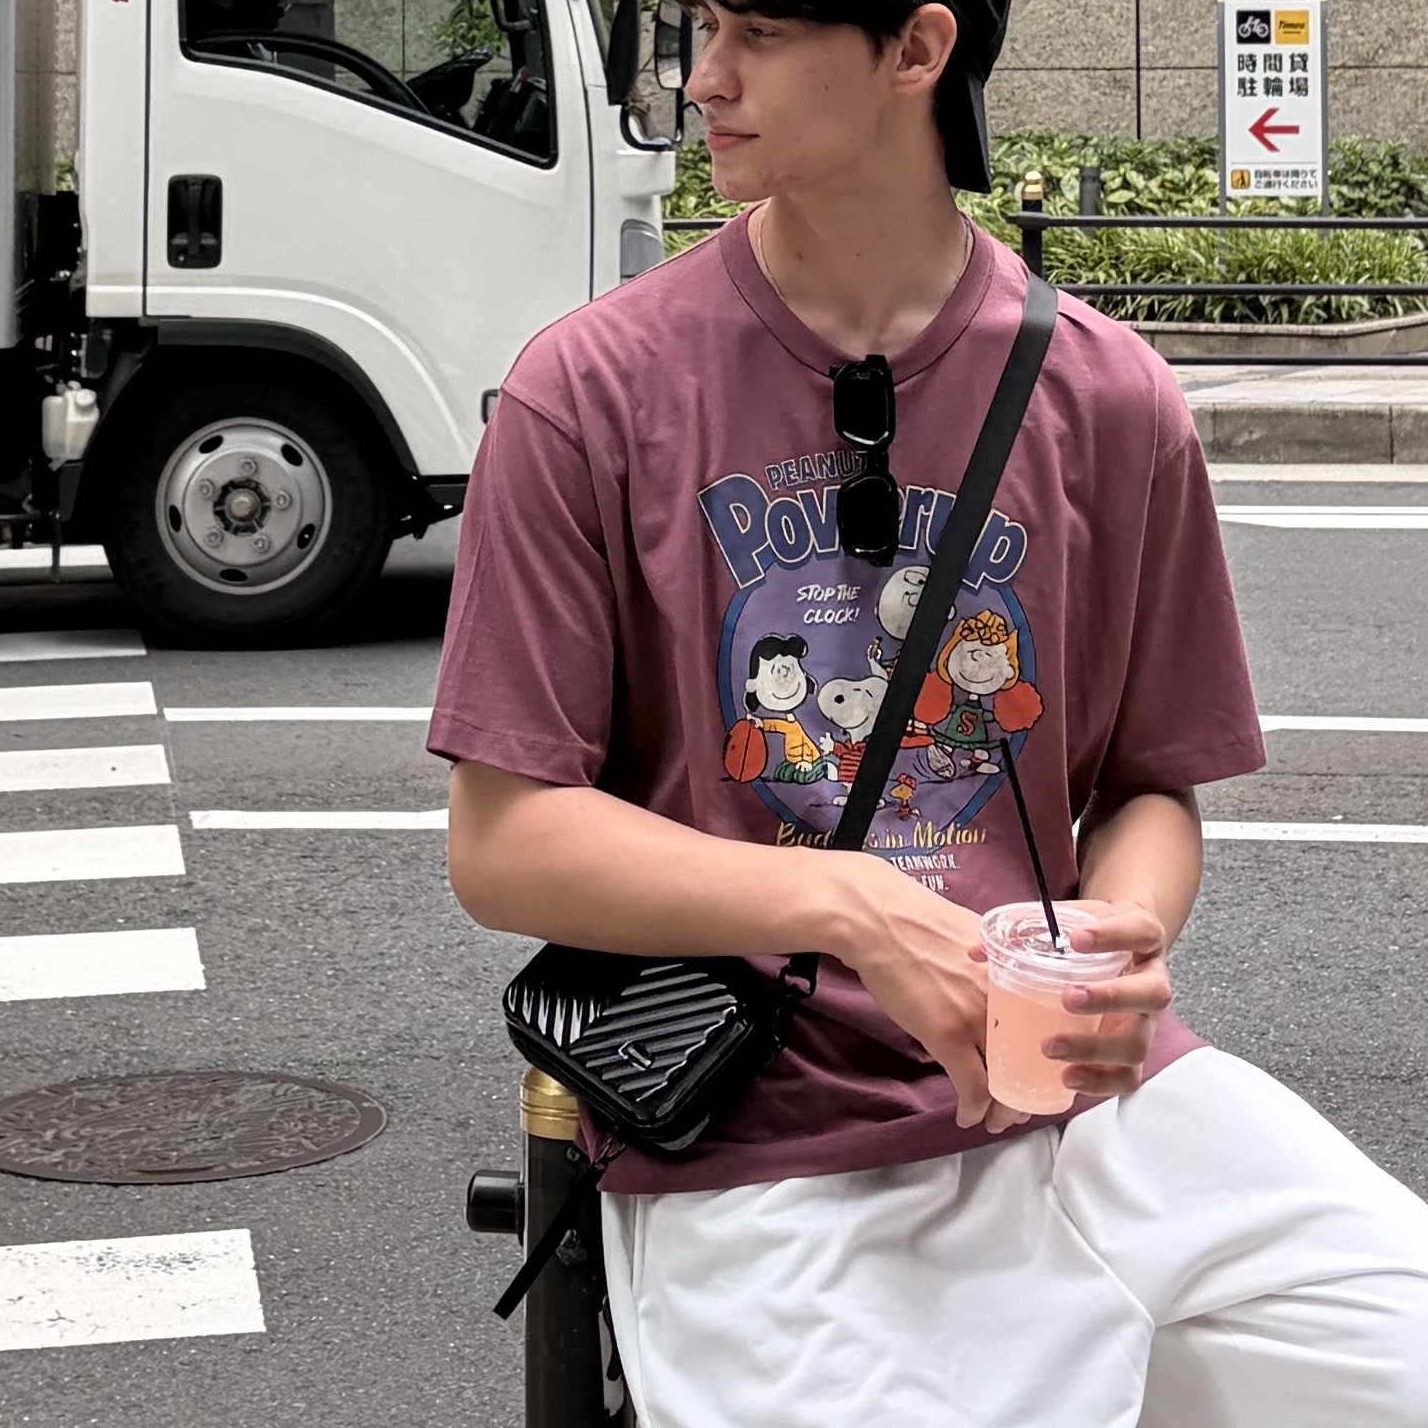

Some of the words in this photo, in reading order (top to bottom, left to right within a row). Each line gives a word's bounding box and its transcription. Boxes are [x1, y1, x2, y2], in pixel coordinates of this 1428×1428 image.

[1237, 53, 1309, 73] 時間貸
[1237, 77, 1309, 97] 駐輪場
[765, 450, 872, 490] PEANUT
[797, 585, 834, 602] STOP
[836, 584, 861, 600] THE
[803, 607, 860, 624] CLOCK!
